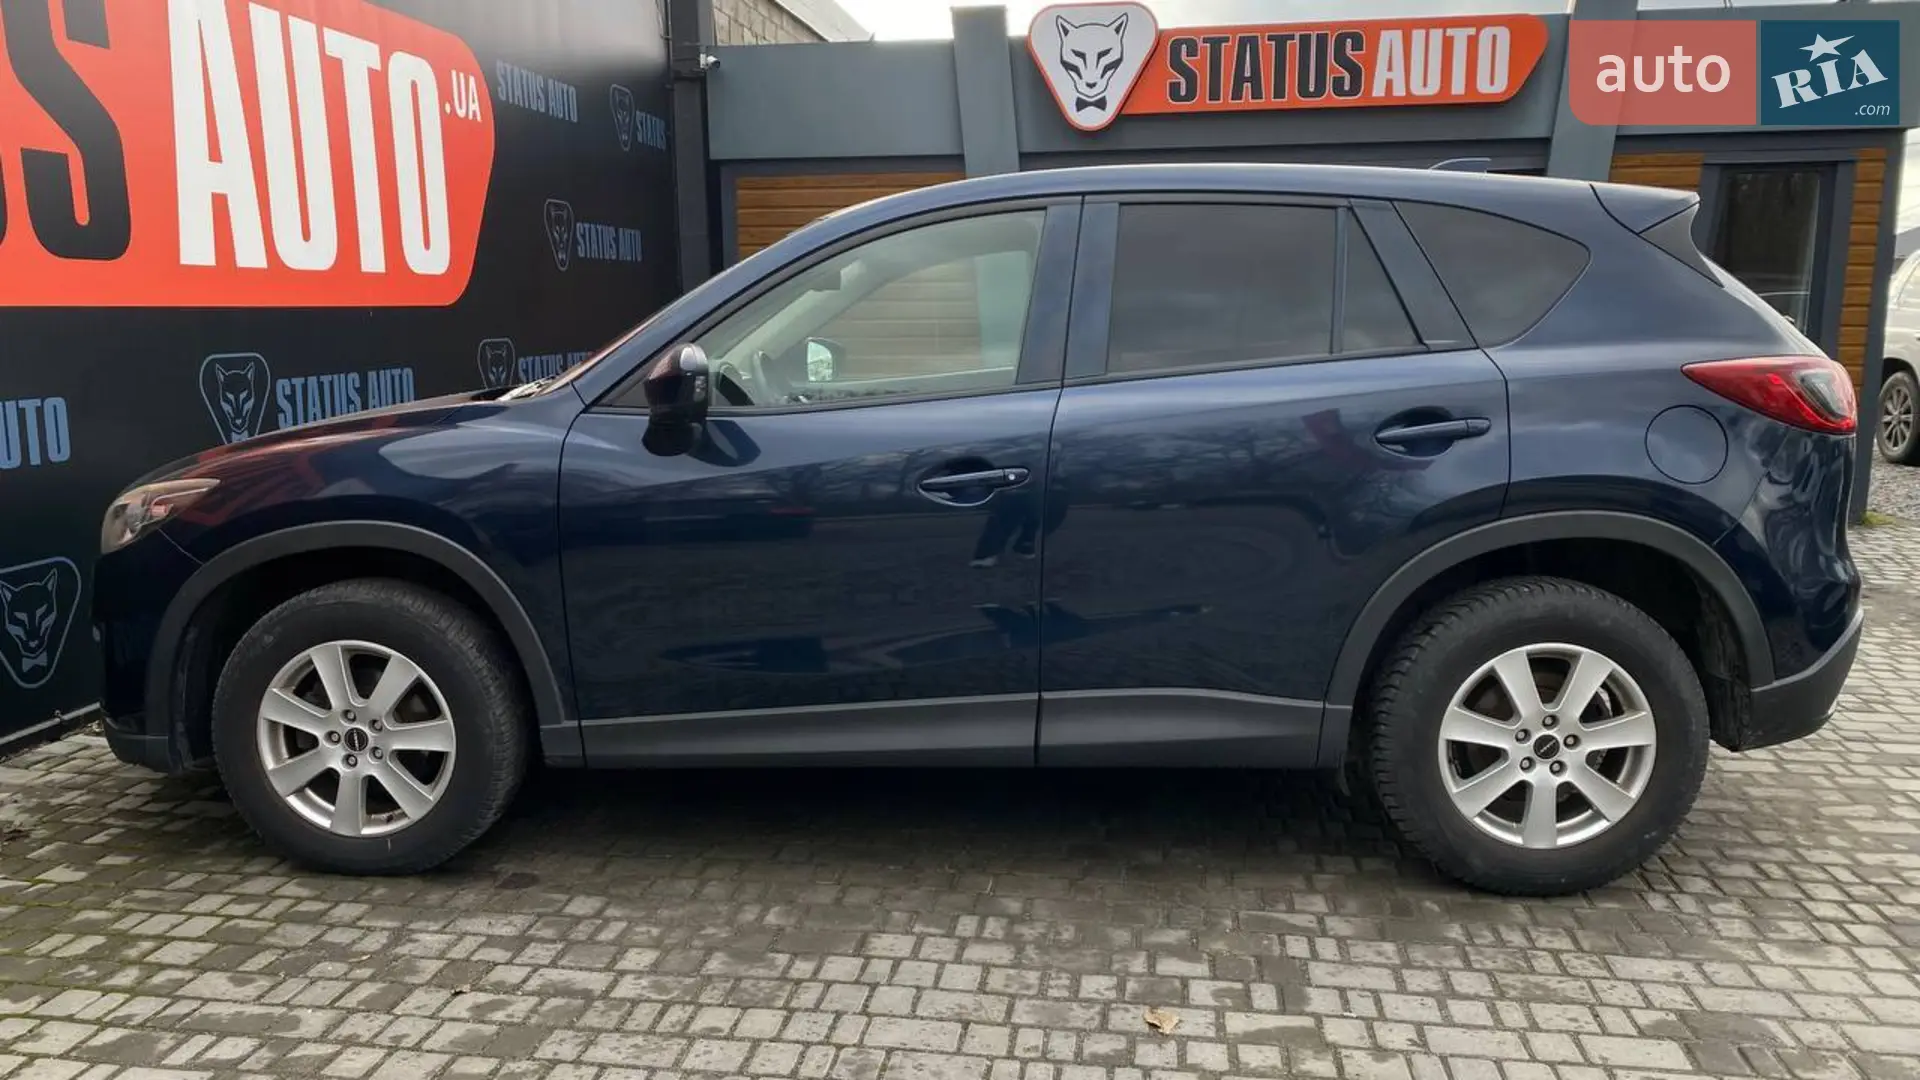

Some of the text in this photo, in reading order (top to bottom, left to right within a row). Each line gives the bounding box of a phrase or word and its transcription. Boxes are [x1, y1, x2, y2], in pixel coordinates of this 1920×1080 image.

[496, 59, 578, 123] STATUS AUTO
[1167, 26, 1511, 104] STATUS AUTO
[636, 110, 667, 151] STATUS
[576, 221, 642, 262] STATUS AUTO
[275, 367, 415, 430] STATUS AUTO
